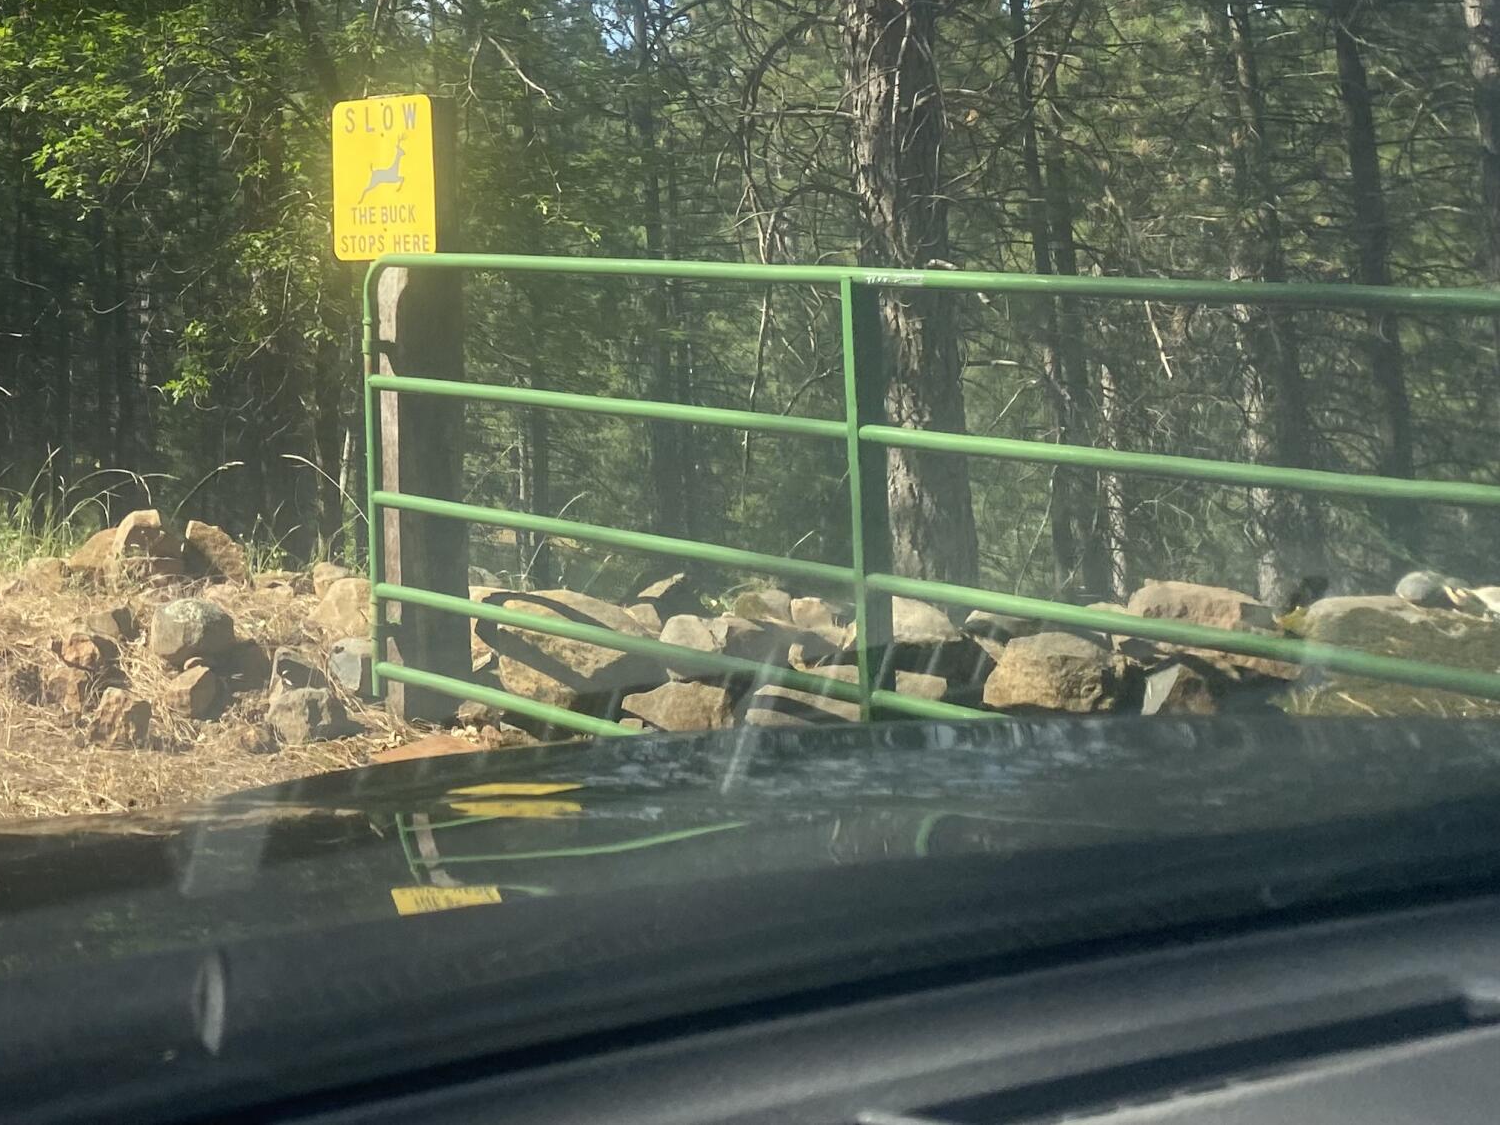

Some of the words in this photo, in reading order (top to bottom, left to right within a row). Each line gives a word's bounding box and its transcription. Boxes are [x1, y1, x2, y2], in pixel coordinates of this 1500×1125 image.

[344, 102, 417, 134] SLOW
[351, 206, 377, 225] THE
[380, 204, 416, 224] BUCK
[341, 234, 385, 253] STOPS
[393, 234, 430, 252] HERE
